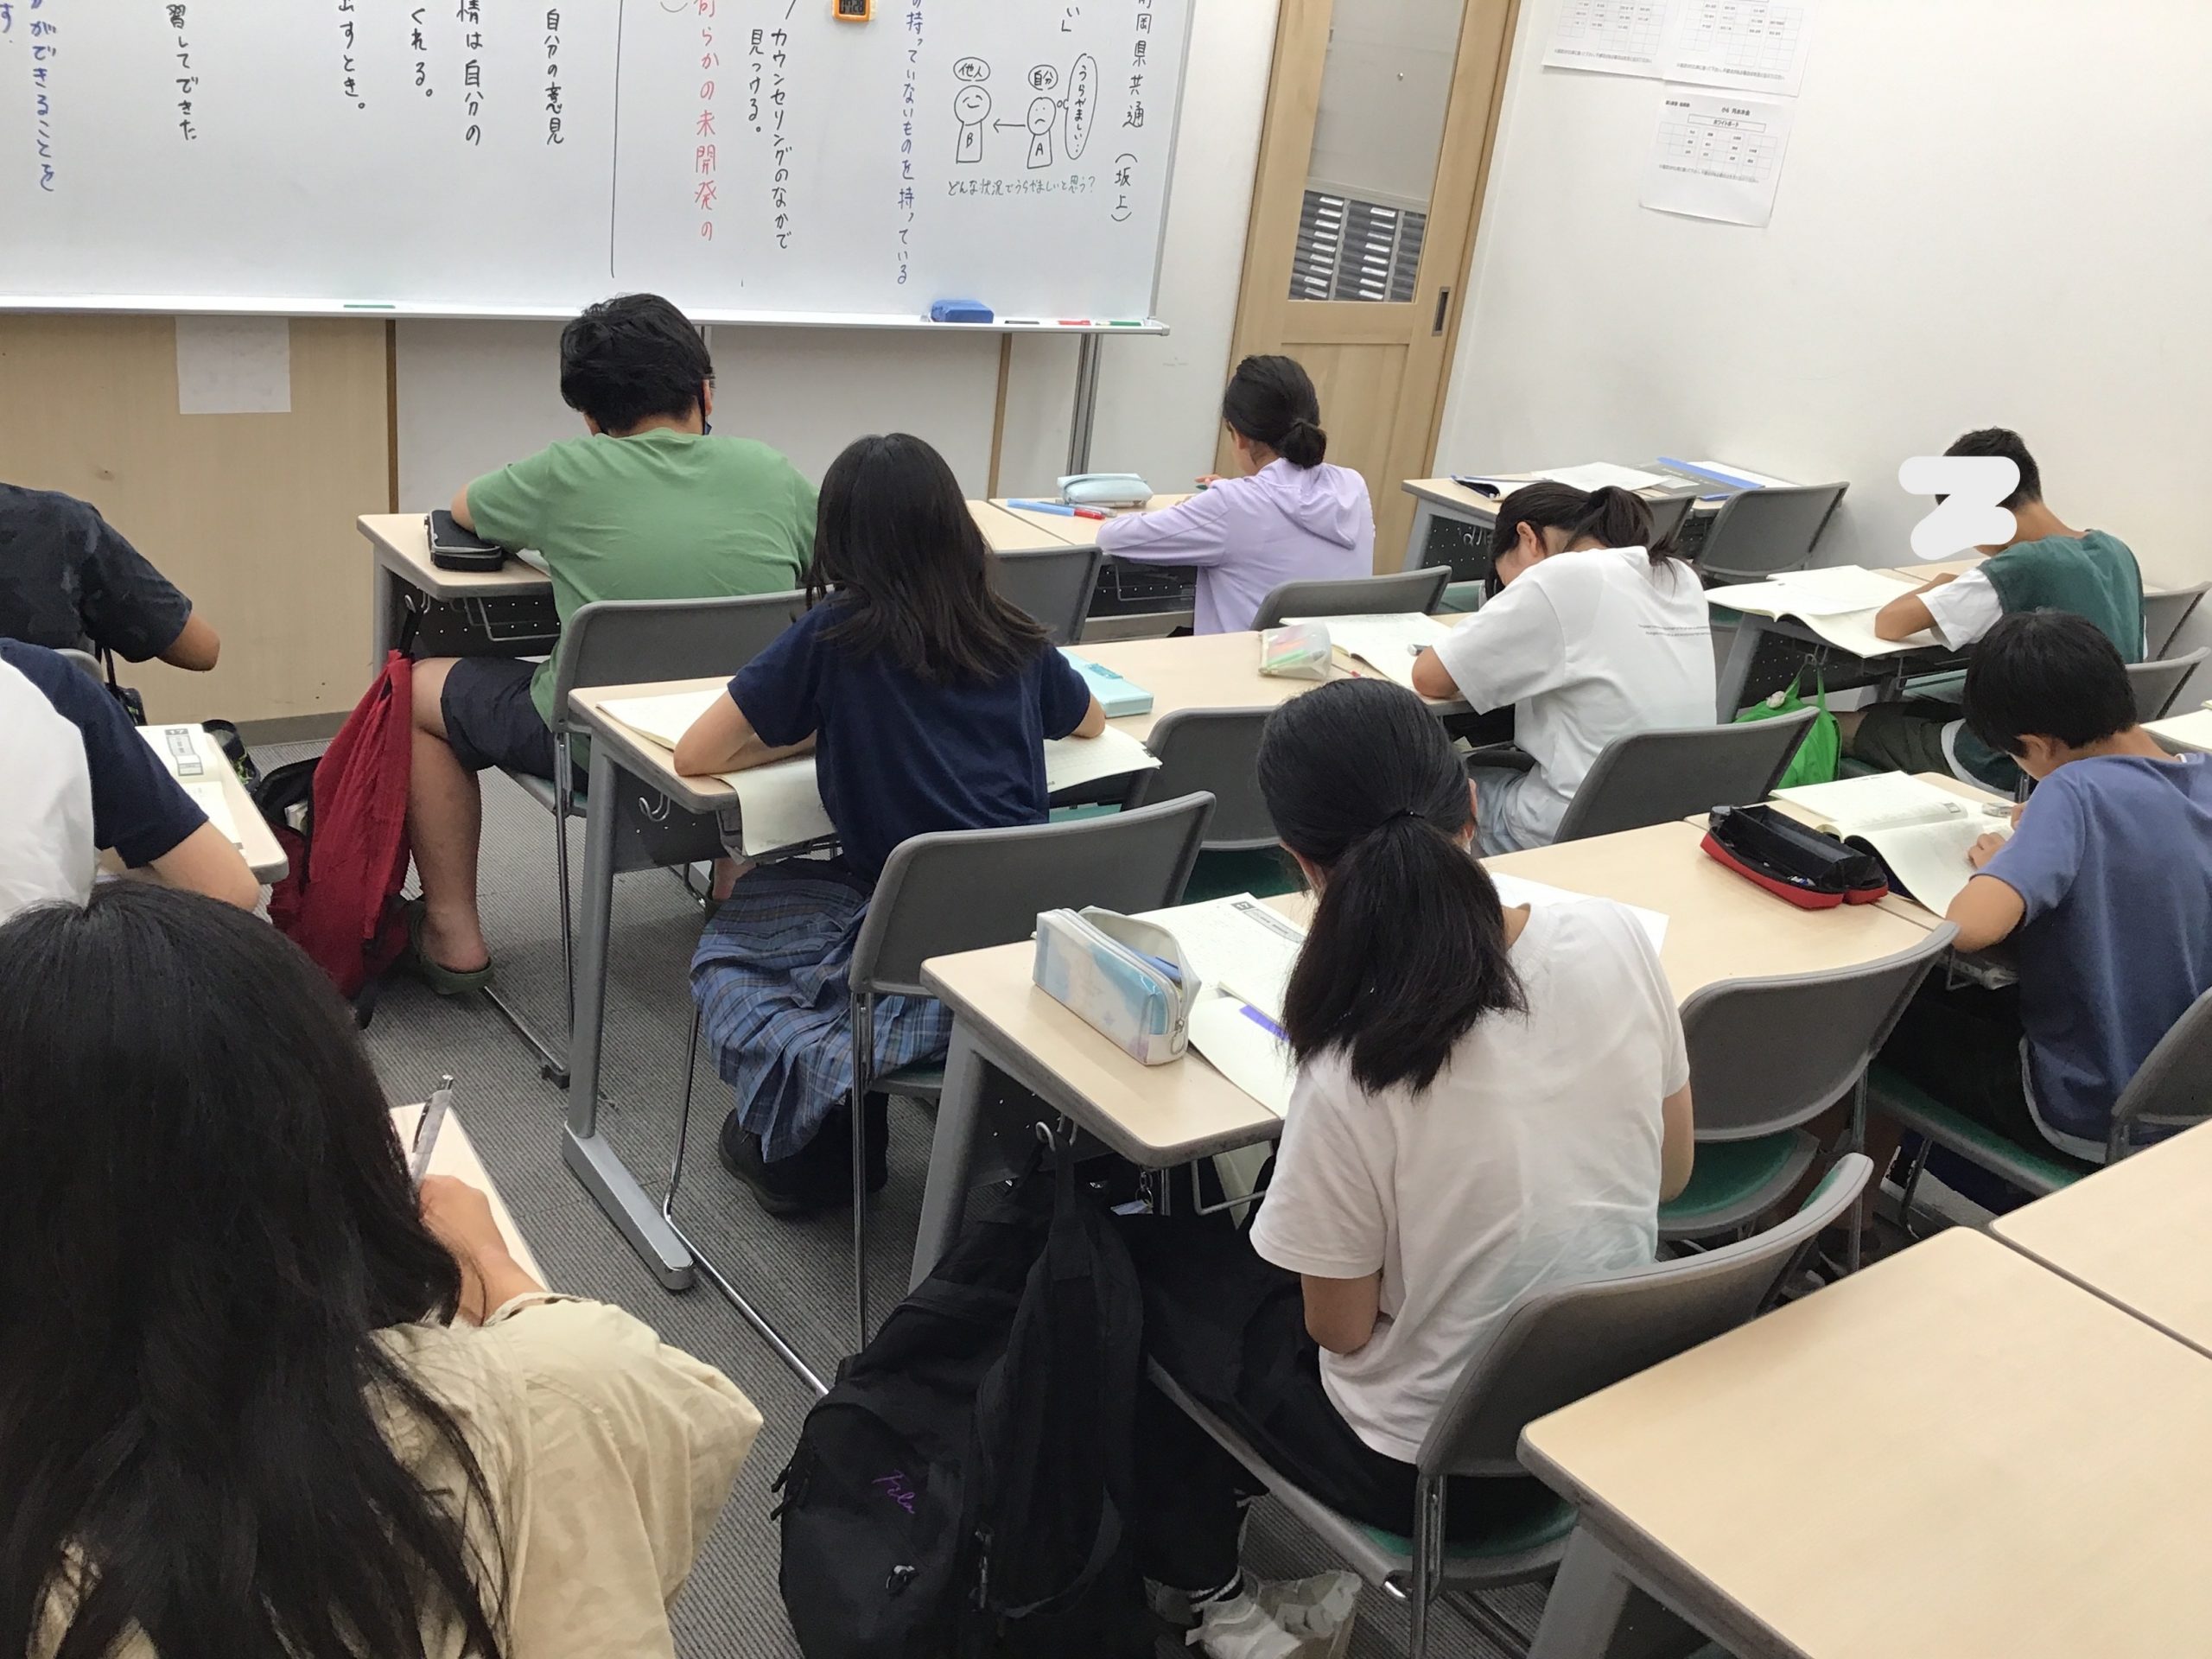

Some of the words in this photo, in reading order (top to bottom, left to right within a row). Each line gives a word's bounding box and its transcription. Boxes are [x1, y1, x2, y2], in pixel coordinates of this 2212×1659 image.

[411, 8, 433, 97] くれる。
[456, 0, 484, 146] 情は自分の
[544, 9, 564, 145] 自分の意見
[958, 63, 982, 79] 他人
[1033, 70, 1053, 86] 自分
[771, 29, 791, 249] カウンセリングのなかで
[966, 132, 974, 149] B
[1035, 143, 1044, 156] A
